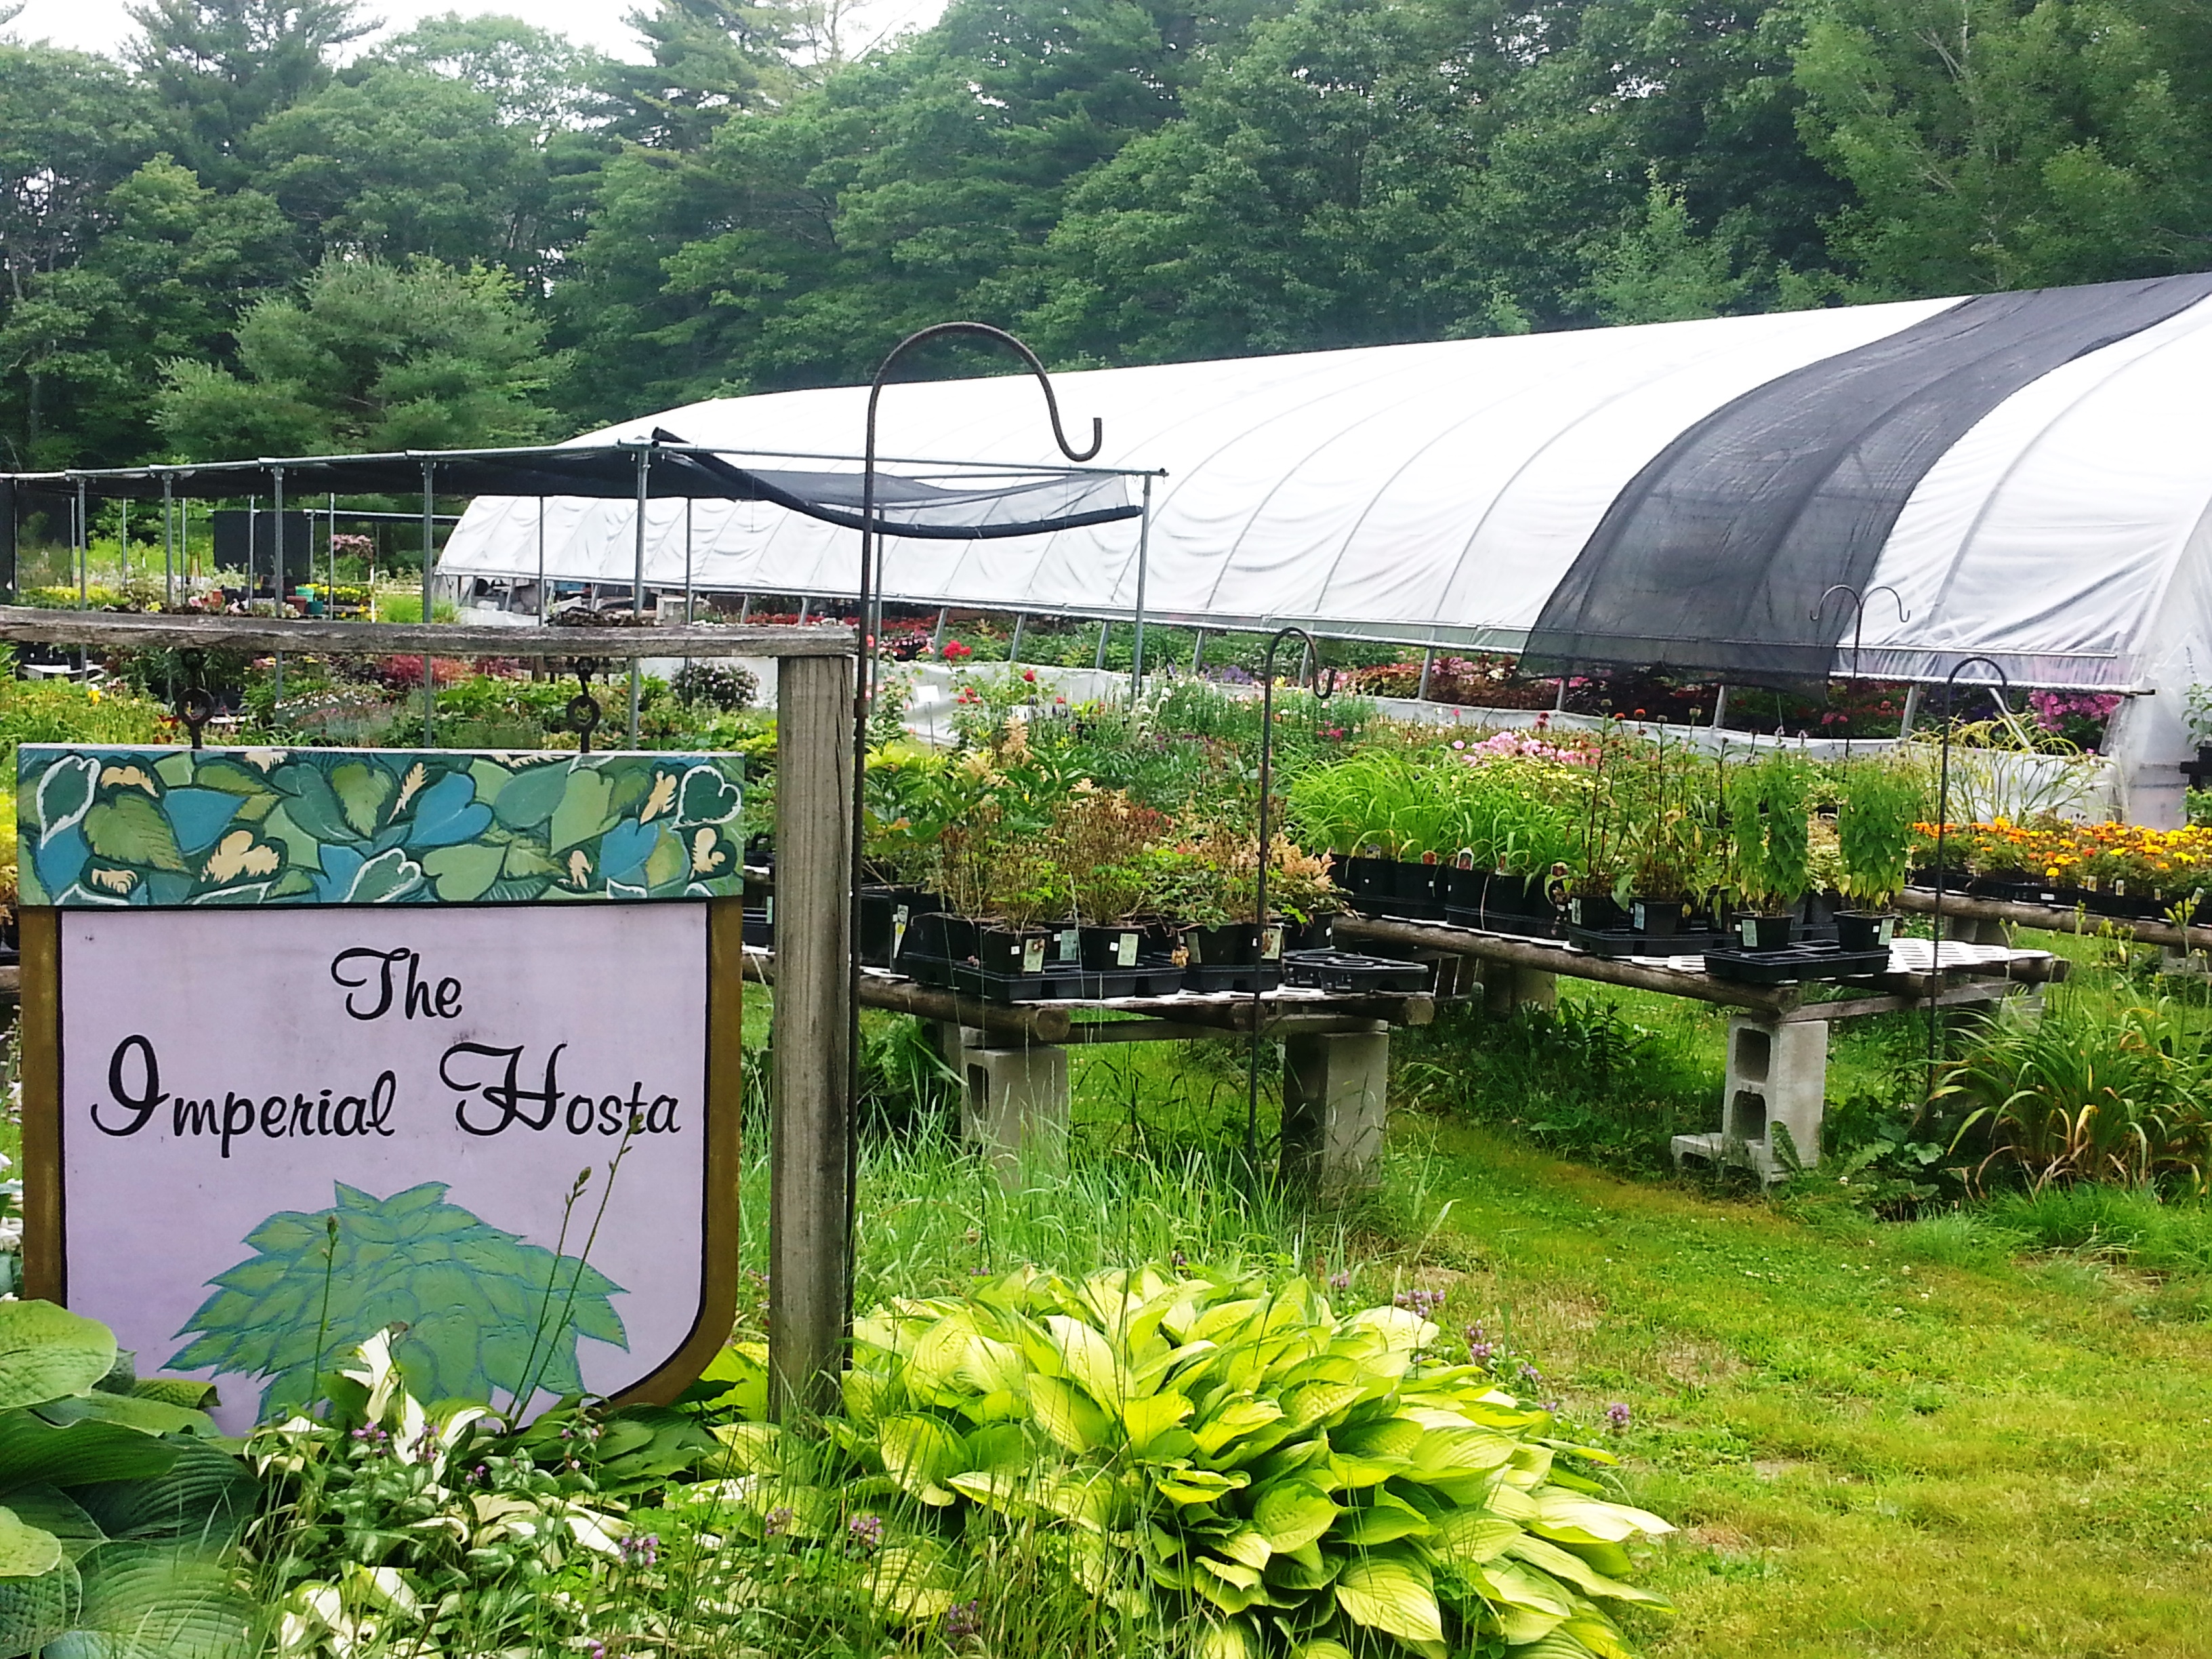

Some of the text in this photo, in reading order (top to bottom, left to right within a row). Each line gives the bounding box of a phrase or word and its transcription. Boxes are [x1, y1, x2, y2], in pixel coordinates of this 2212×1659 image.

[331, 947, 463, 1021] The
[90, 1034, 682, 1159] Imperial Hosta
